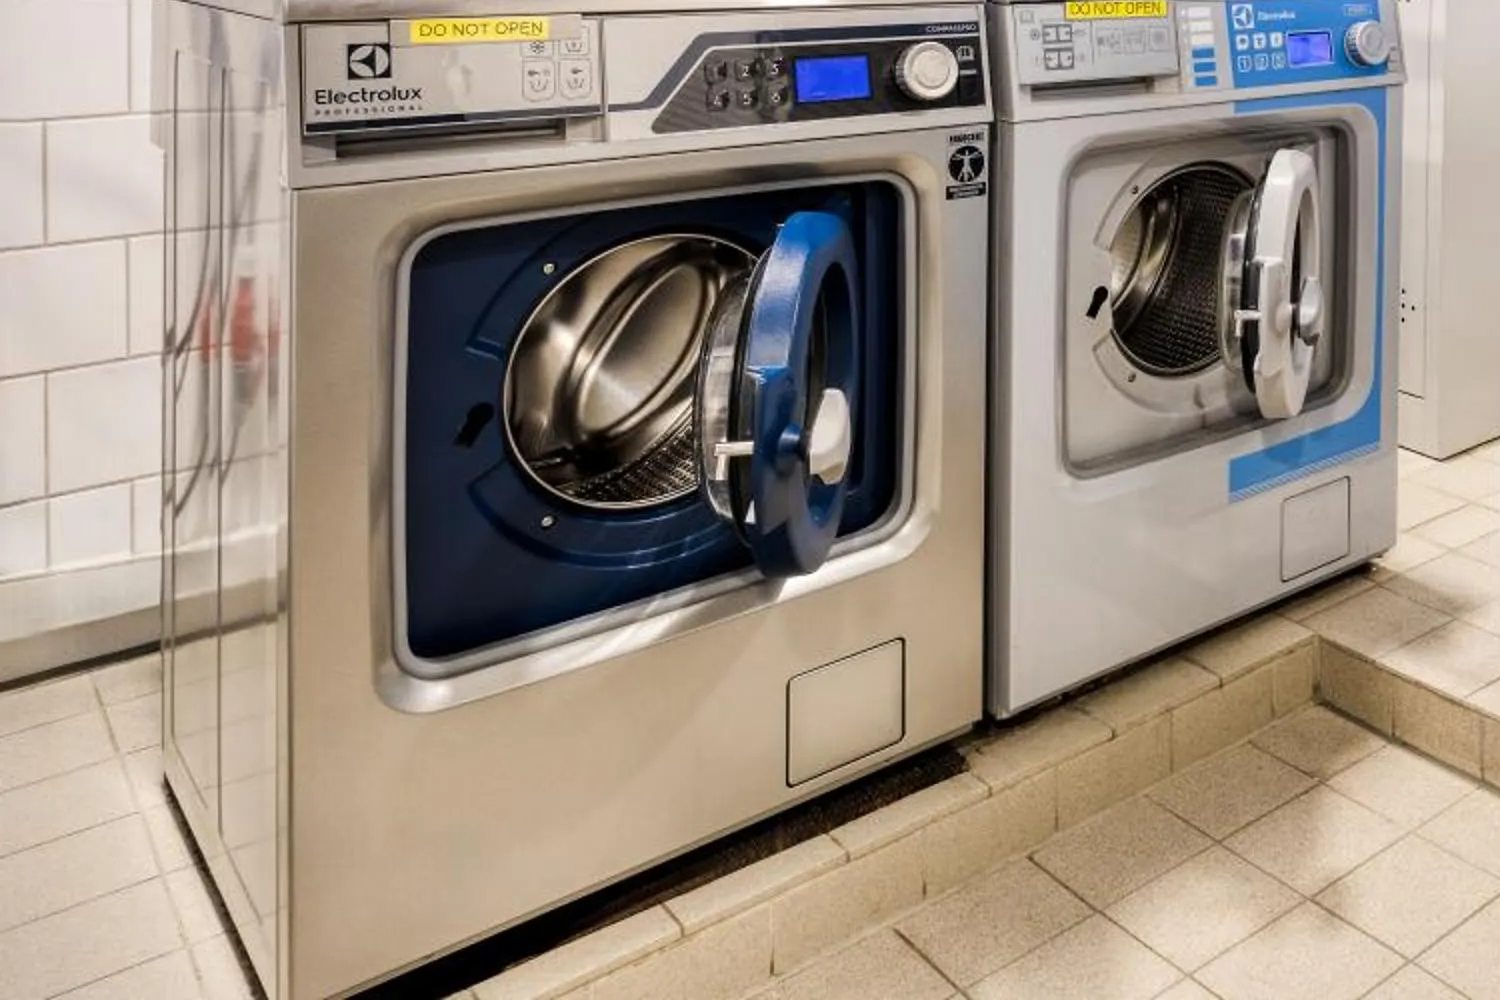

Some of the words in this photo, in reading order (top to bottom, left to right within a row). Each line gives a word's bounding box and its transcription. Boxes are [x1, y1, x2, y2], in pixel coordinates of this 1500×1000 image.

[1070, 2, 1090, 16] DO
[1094, 1, 1121, 15] NOT
[1124, 1, 1161, 14] OPEN
[419, 22, 448, 38] DO
[452, 22, 491, 37] NOT
[495, 20, 544, 36] OPEN
[314, 85, 423, 106] Electrolux
